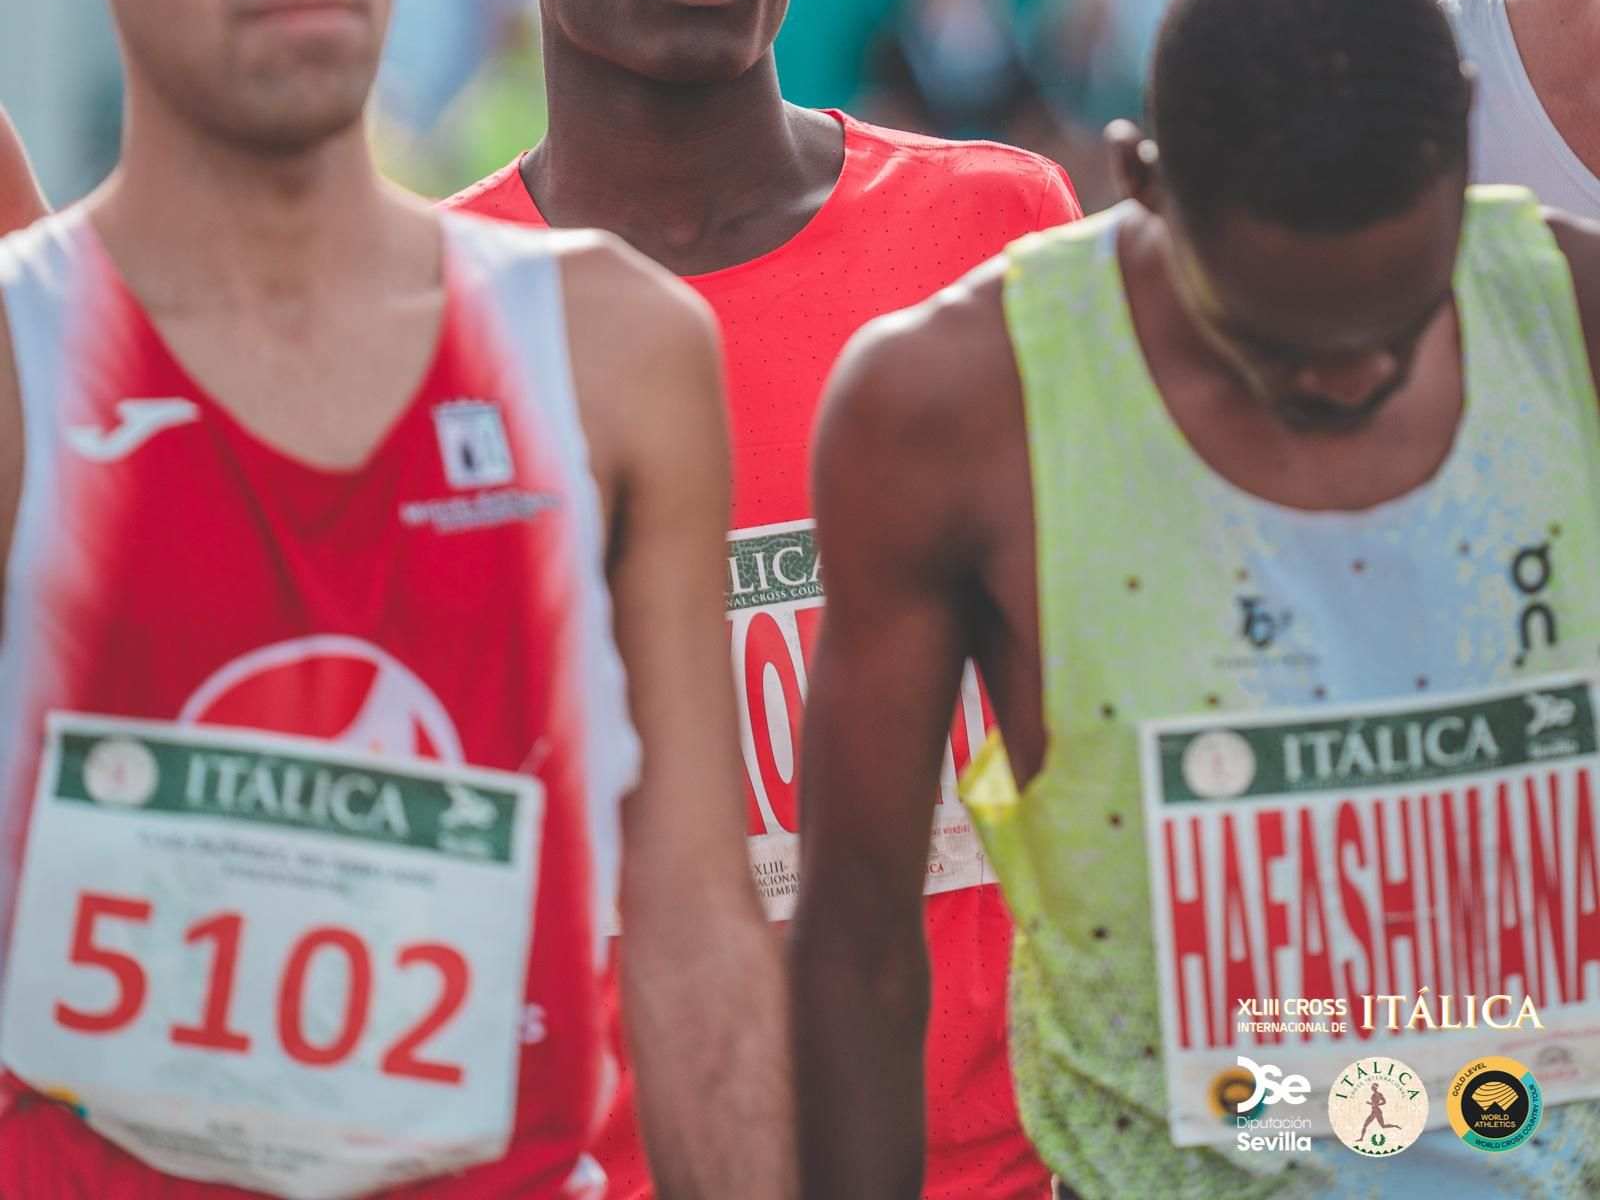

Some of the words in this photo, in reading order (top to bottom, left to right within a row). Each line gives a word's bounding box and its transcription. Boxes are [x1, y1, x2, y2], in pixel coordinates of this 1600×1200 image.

[726, 597, 747, 608] NAL
[751, 590, 786, 604] CROSS
[790, 584, 824, 597] COUN
[1282, 714, 1500, 784] ITÁLICA
[183, 751, 412, 837] ITÁLICA
[760, 884, 799, 898] VIEMBR
[52, 889, 471, 1087] 5102
